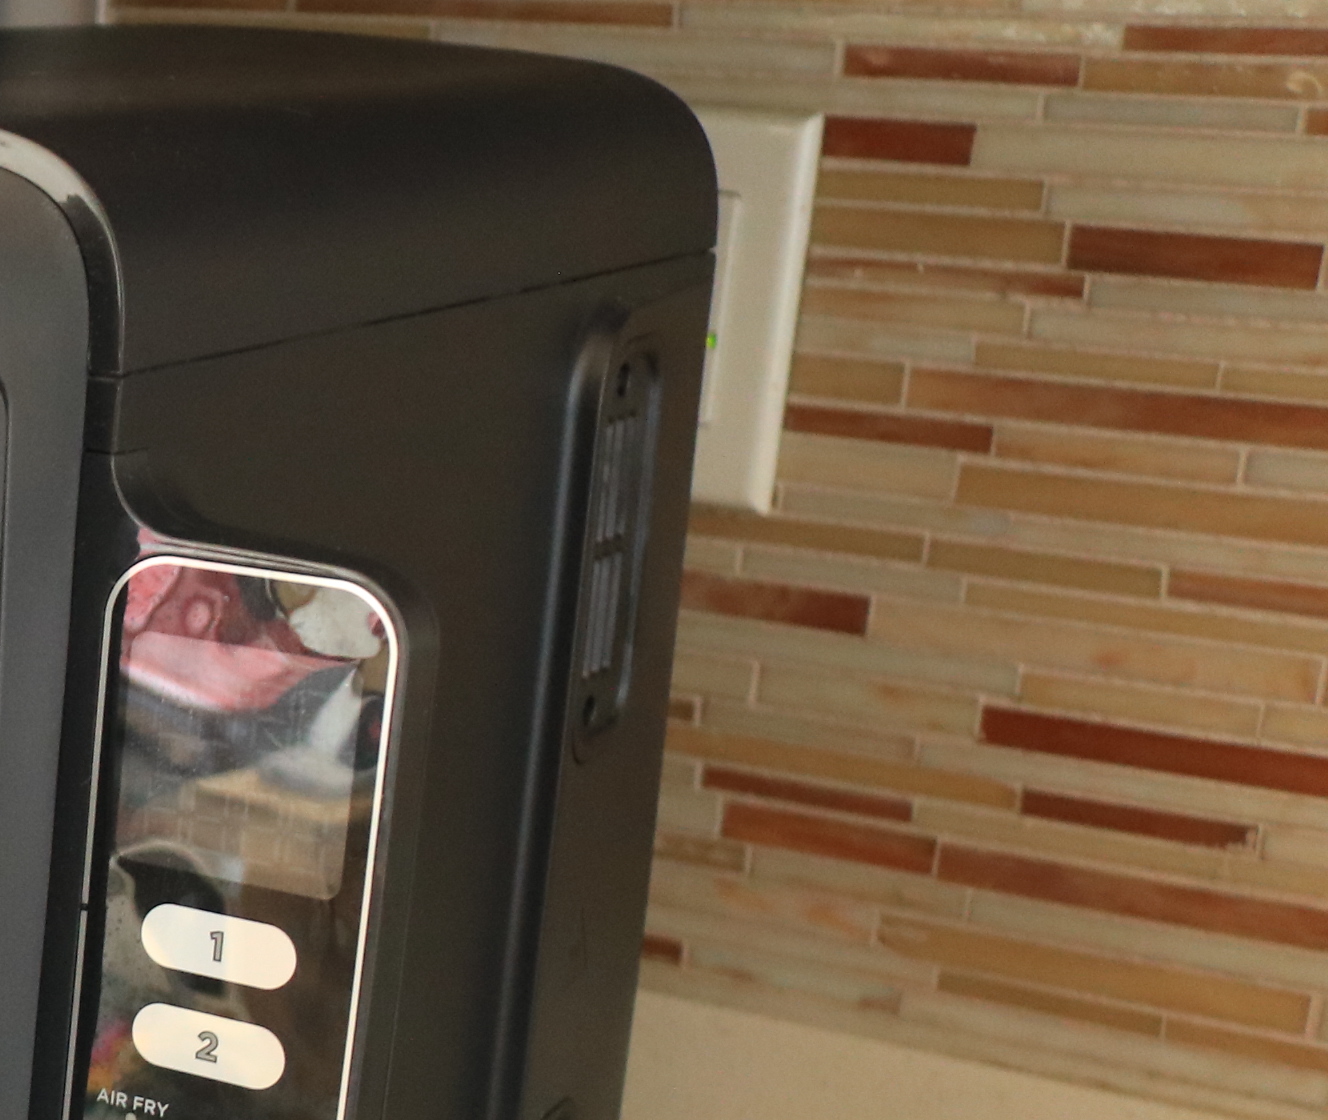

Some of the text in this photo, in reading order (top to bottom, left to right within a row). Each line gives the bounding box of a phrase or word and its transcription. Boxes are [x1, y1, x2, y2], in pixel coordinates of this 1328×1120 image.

[210, 931, 225, 962] 1
[195, 1031, 219, 1063] 2
[96, 1088, 170, 1119] AIR FRY
